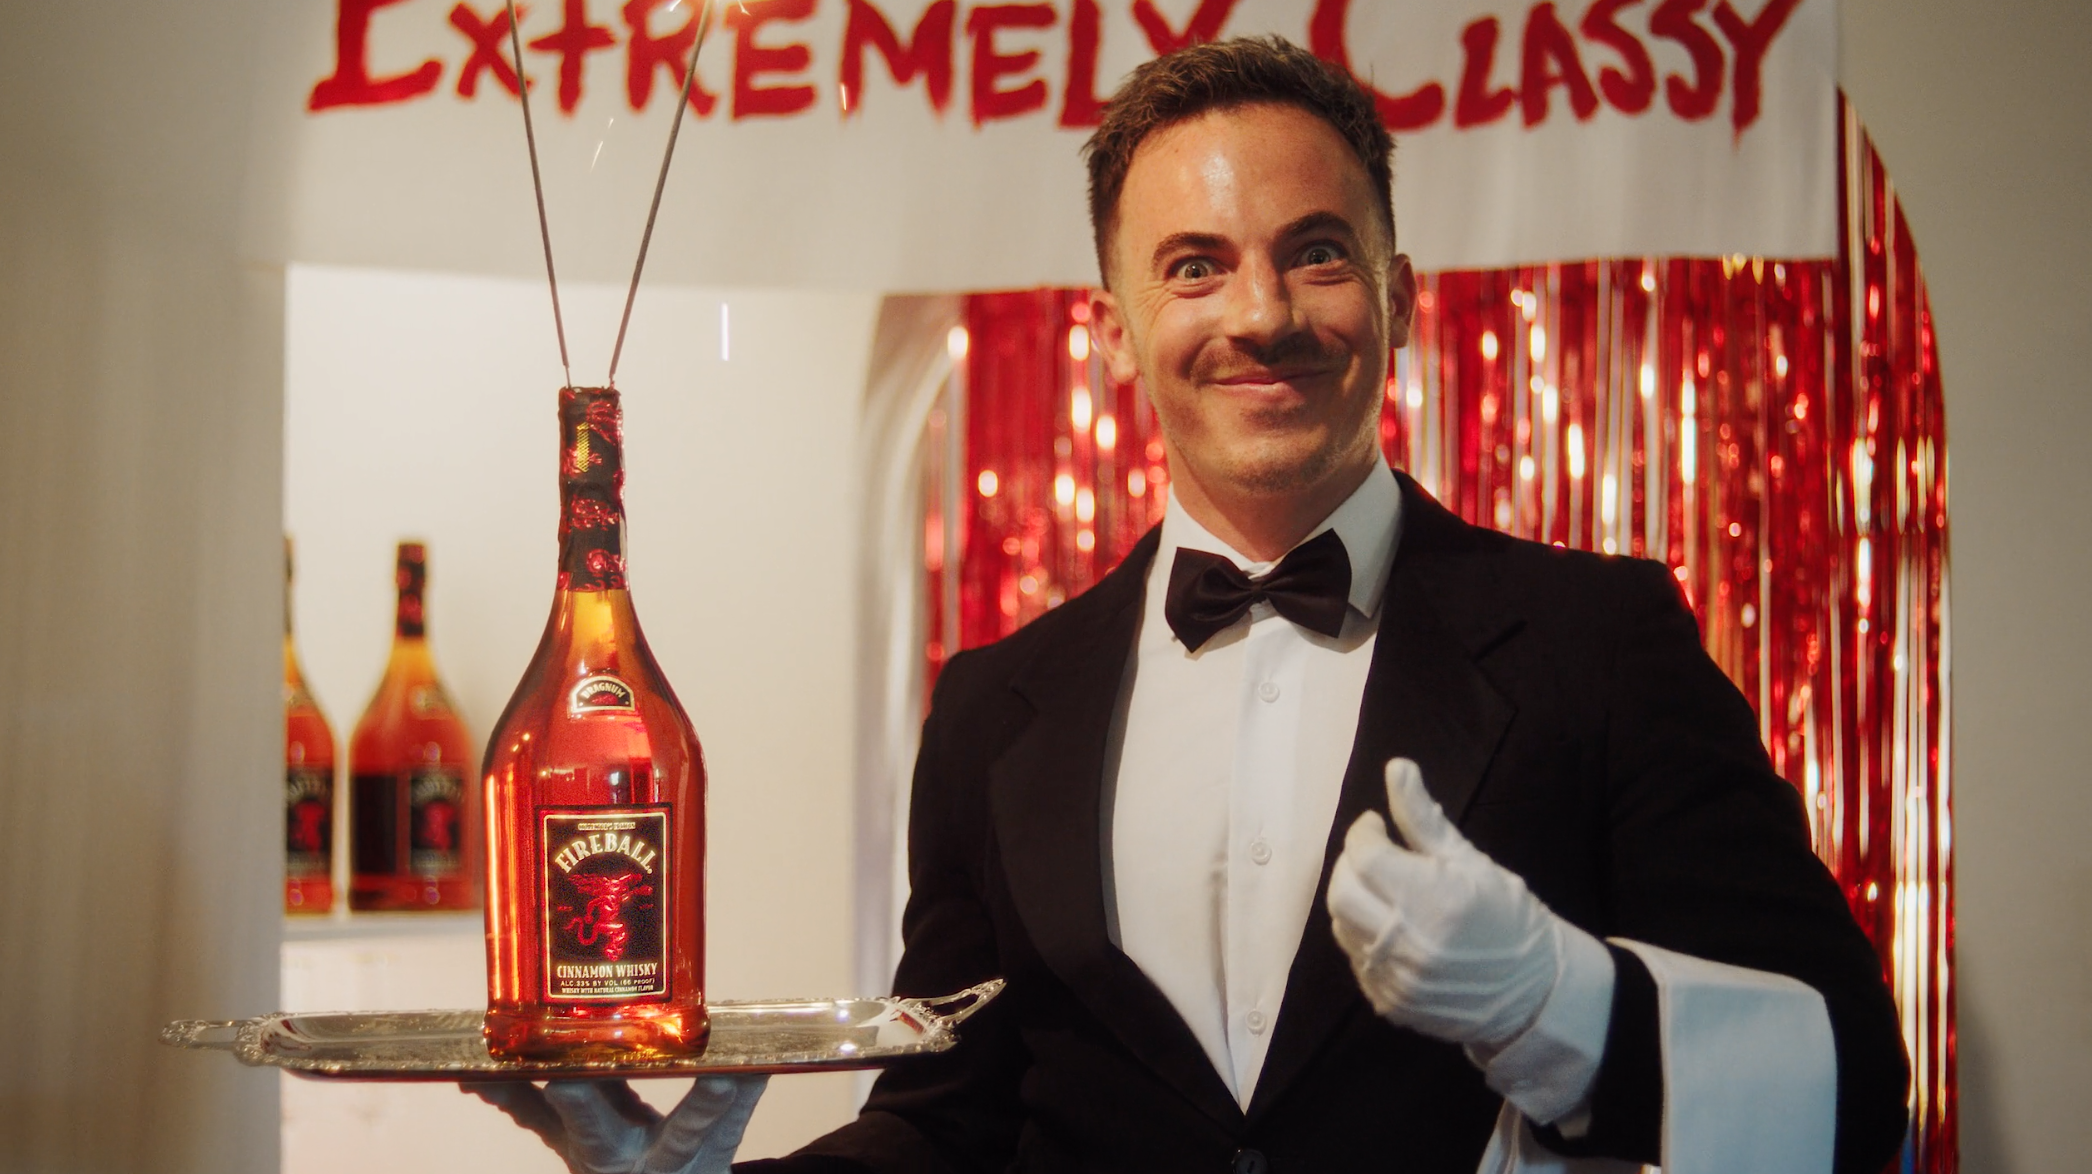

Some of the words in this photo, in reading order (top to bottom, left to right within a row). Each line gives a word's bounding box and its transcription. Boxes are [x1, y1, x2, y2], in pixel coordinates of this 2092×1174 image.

[1309, 0, 1798, 136] CLASSY
[555, 832, 656, 874] FIREBALL
[557, 965, 613, 978] CINNAMON
[616, 962, 658, 976] WHISKY
[604, 979, 618, 987] VOL
